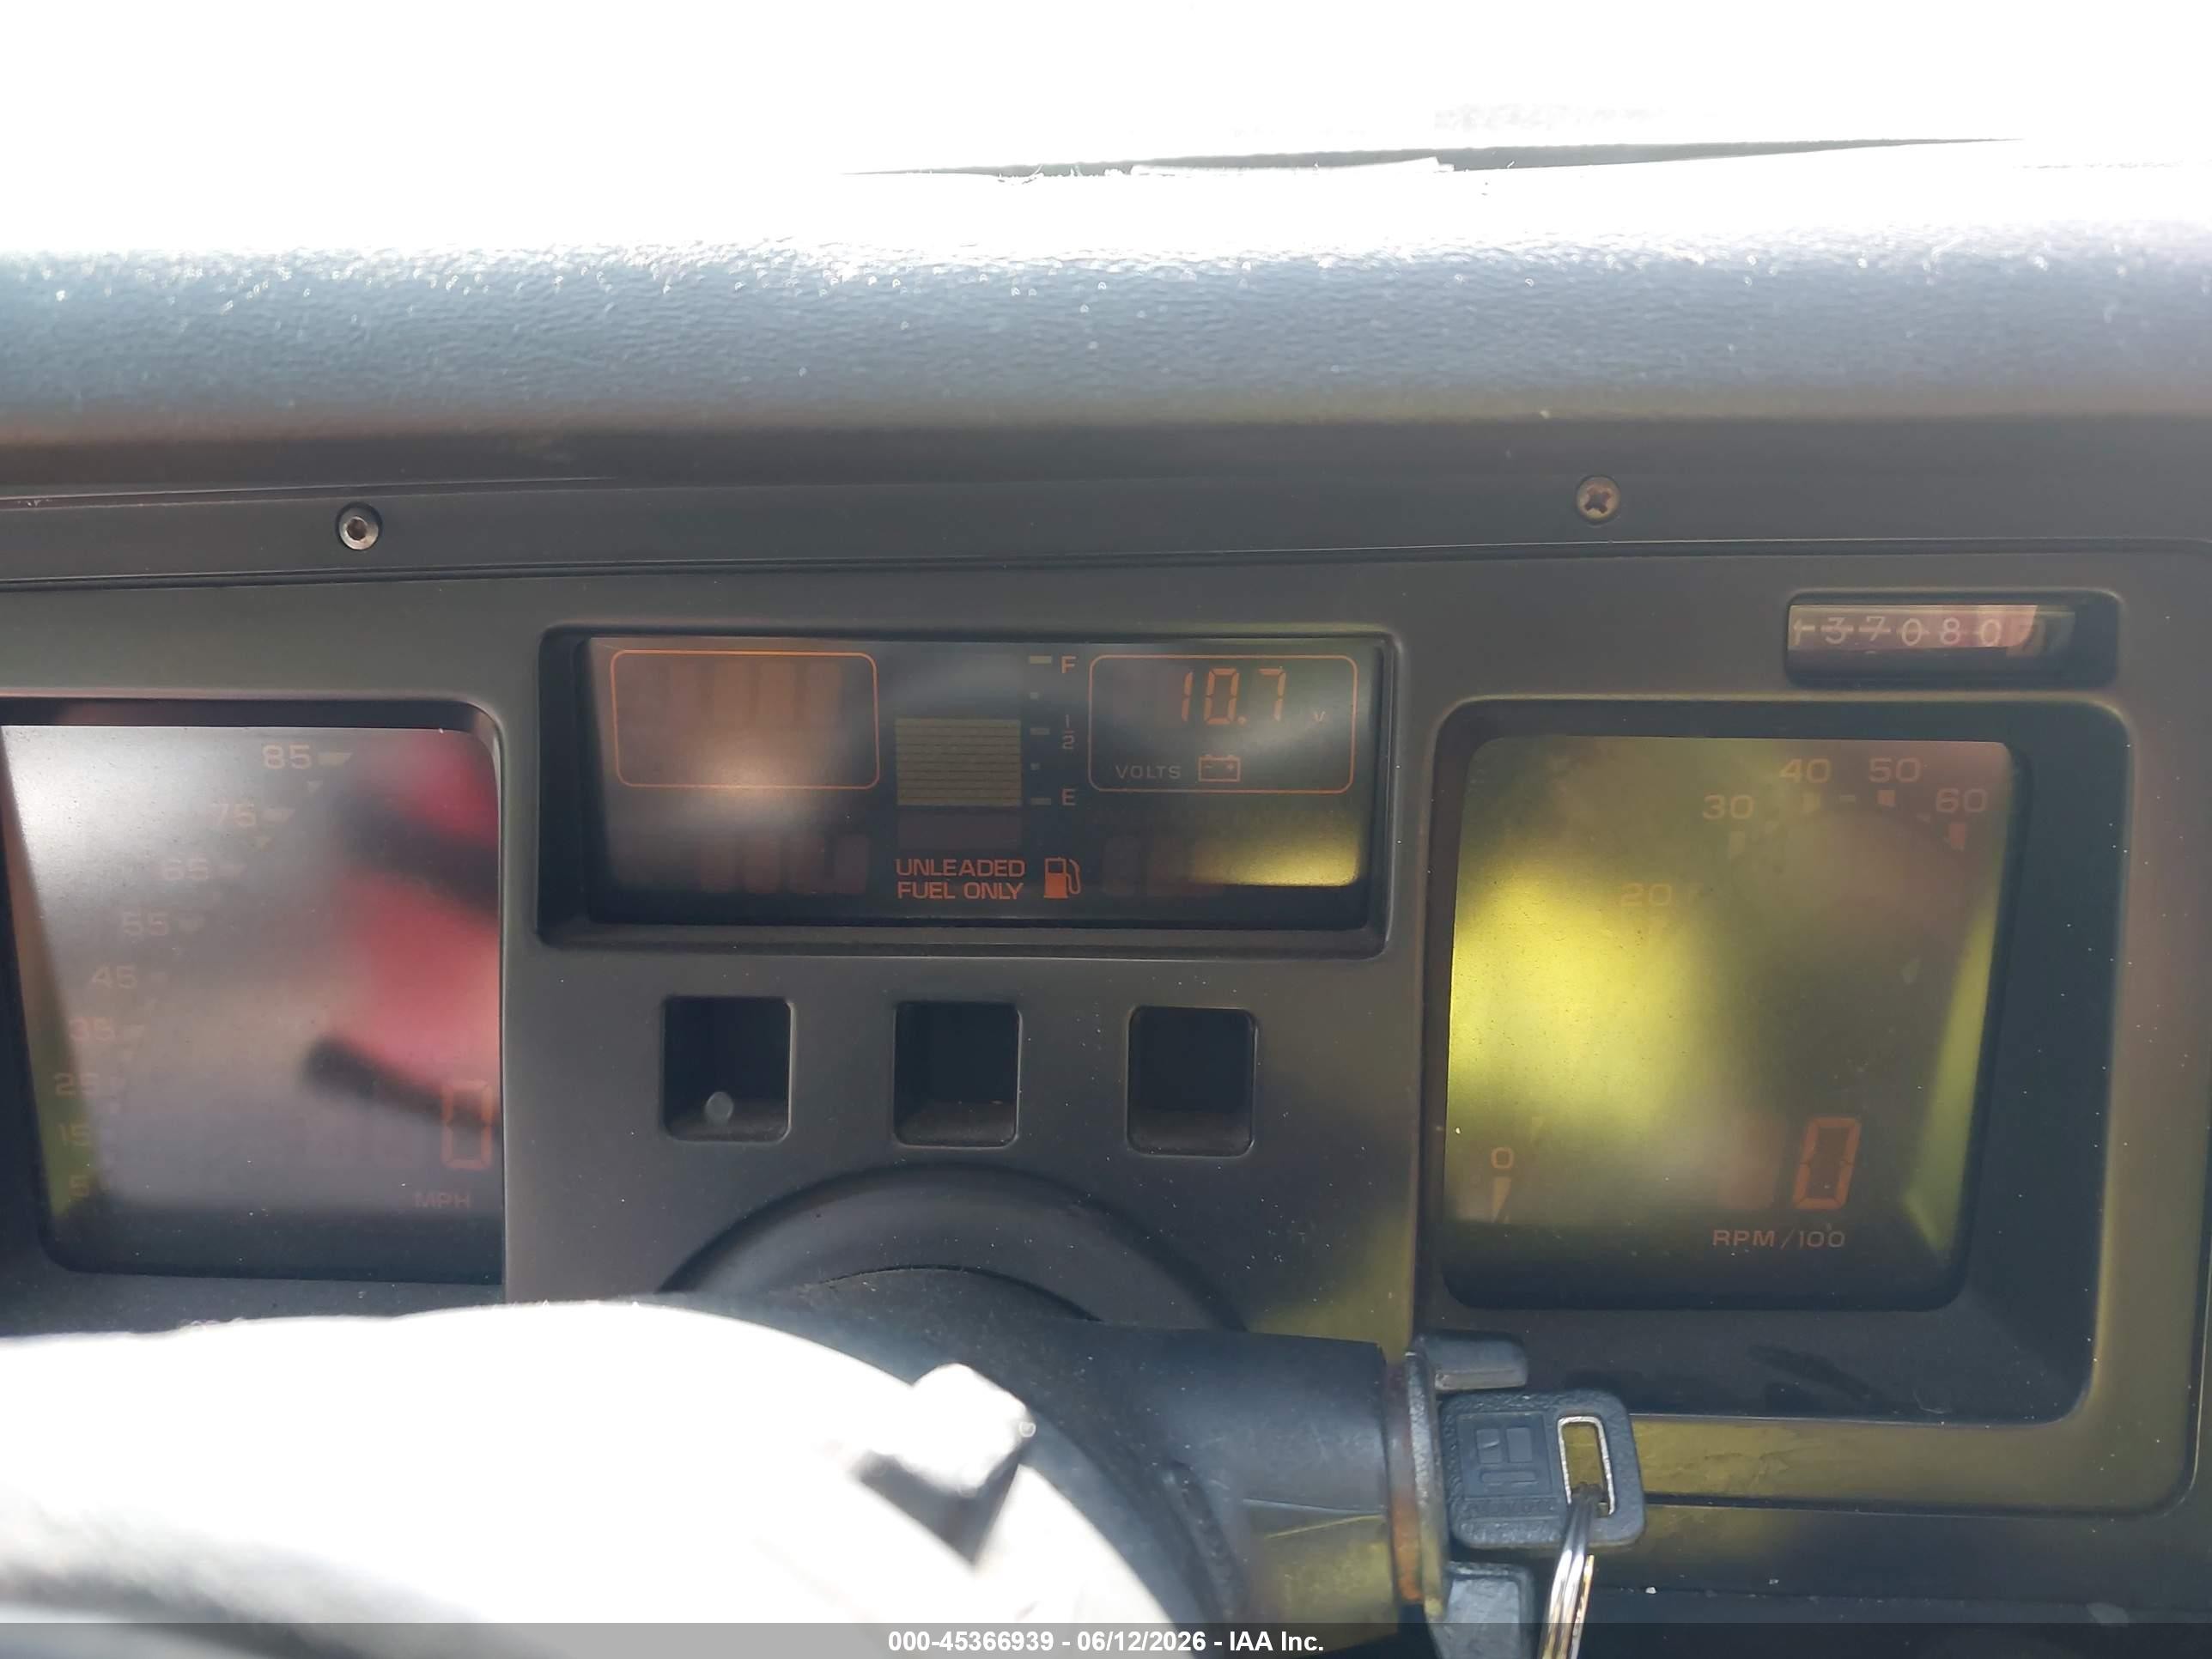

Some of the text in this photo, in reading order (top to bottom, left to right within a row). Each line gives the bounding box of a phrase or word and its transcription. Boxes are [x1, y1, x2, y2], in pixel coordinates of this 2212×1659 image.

[1061, 655, 1077, 674] F
[1180, 667, 1286, 726] 10.7
[261, 744, 312, 770] 85
[1115, 764, 1182, 780] VOLTS
[1778, 758, 1832, 784] 40
[1868, 757, 1922, 783] 50
[1061, 788, 1076, 806] E
[1702, 793, 1754, 819] 30
[1935, 787, 1988, 813] 60
[212, 802, 257, 827] 75
[161, 858, 210, 882] 65
[896, 858, 1025, 878] UNLEADED
[897, 881, 1024, 900] FUEL ONLY
[1620, 883, 1672, 908] 20
[122, 911, 169, 936] 55
[91, 965, 138, 988] 45
[70, 1017, 116, 1042] 35
[52, 1073, 100, 1097] 25
[58, 1121, 91, 1147] 15
[441, 1079, 493, 1170] 0
[1490, 1146, 1514, 1169] 0
[1792, 1117, 1862, 1210] 0
[68, 1174, 89, 1198] 5
[413, 1191, 471, 1210] MPH
